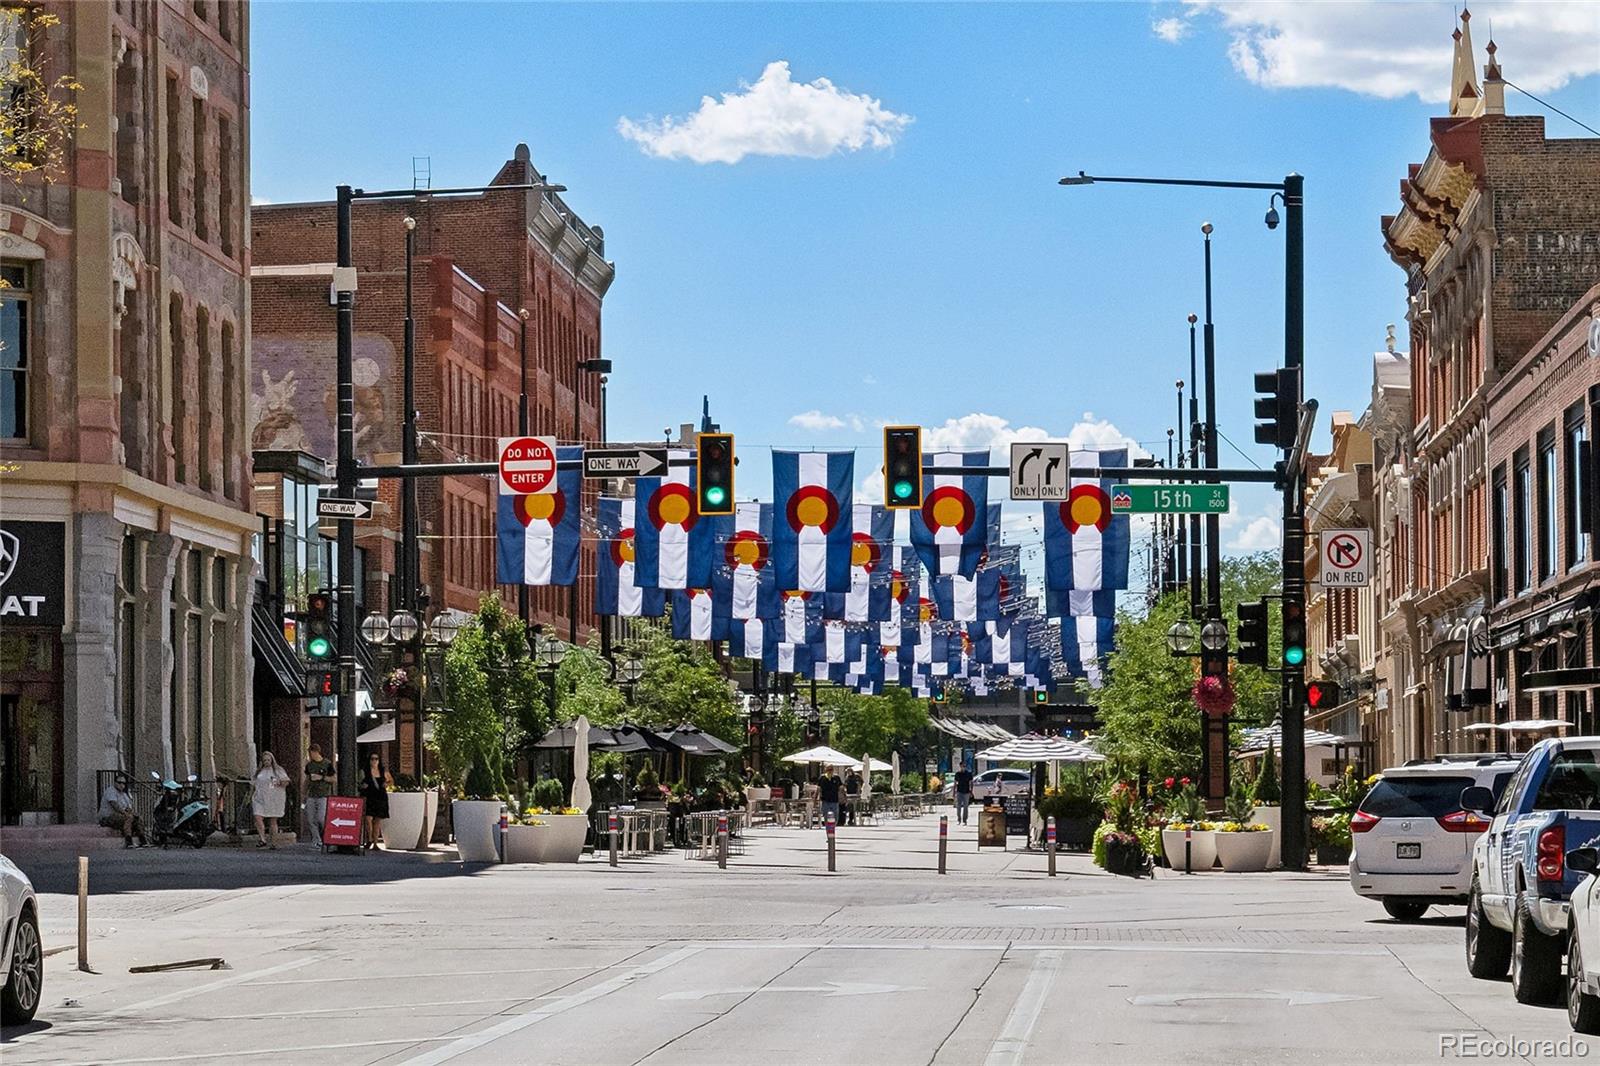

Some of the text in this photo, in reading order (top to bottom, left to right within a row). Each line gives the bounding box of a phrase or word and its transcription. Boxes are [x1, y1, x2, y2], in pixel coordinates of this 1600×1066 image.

[507, 447, 548, 459] DO NOT
[590, 459, 640, 470] ONE WAY
[511, 473, 545, 484] ENTER
[1014, 486, 1065, 496] ONLY ONLY
[1213, 489, 1221, 498] St
[1153, 489, 1192, 508] 15th
[1208, 499, 1226, 508] 1500
[322, 504, 337, 512] ONE
[1326, 571, 1364, 583] ON RED
